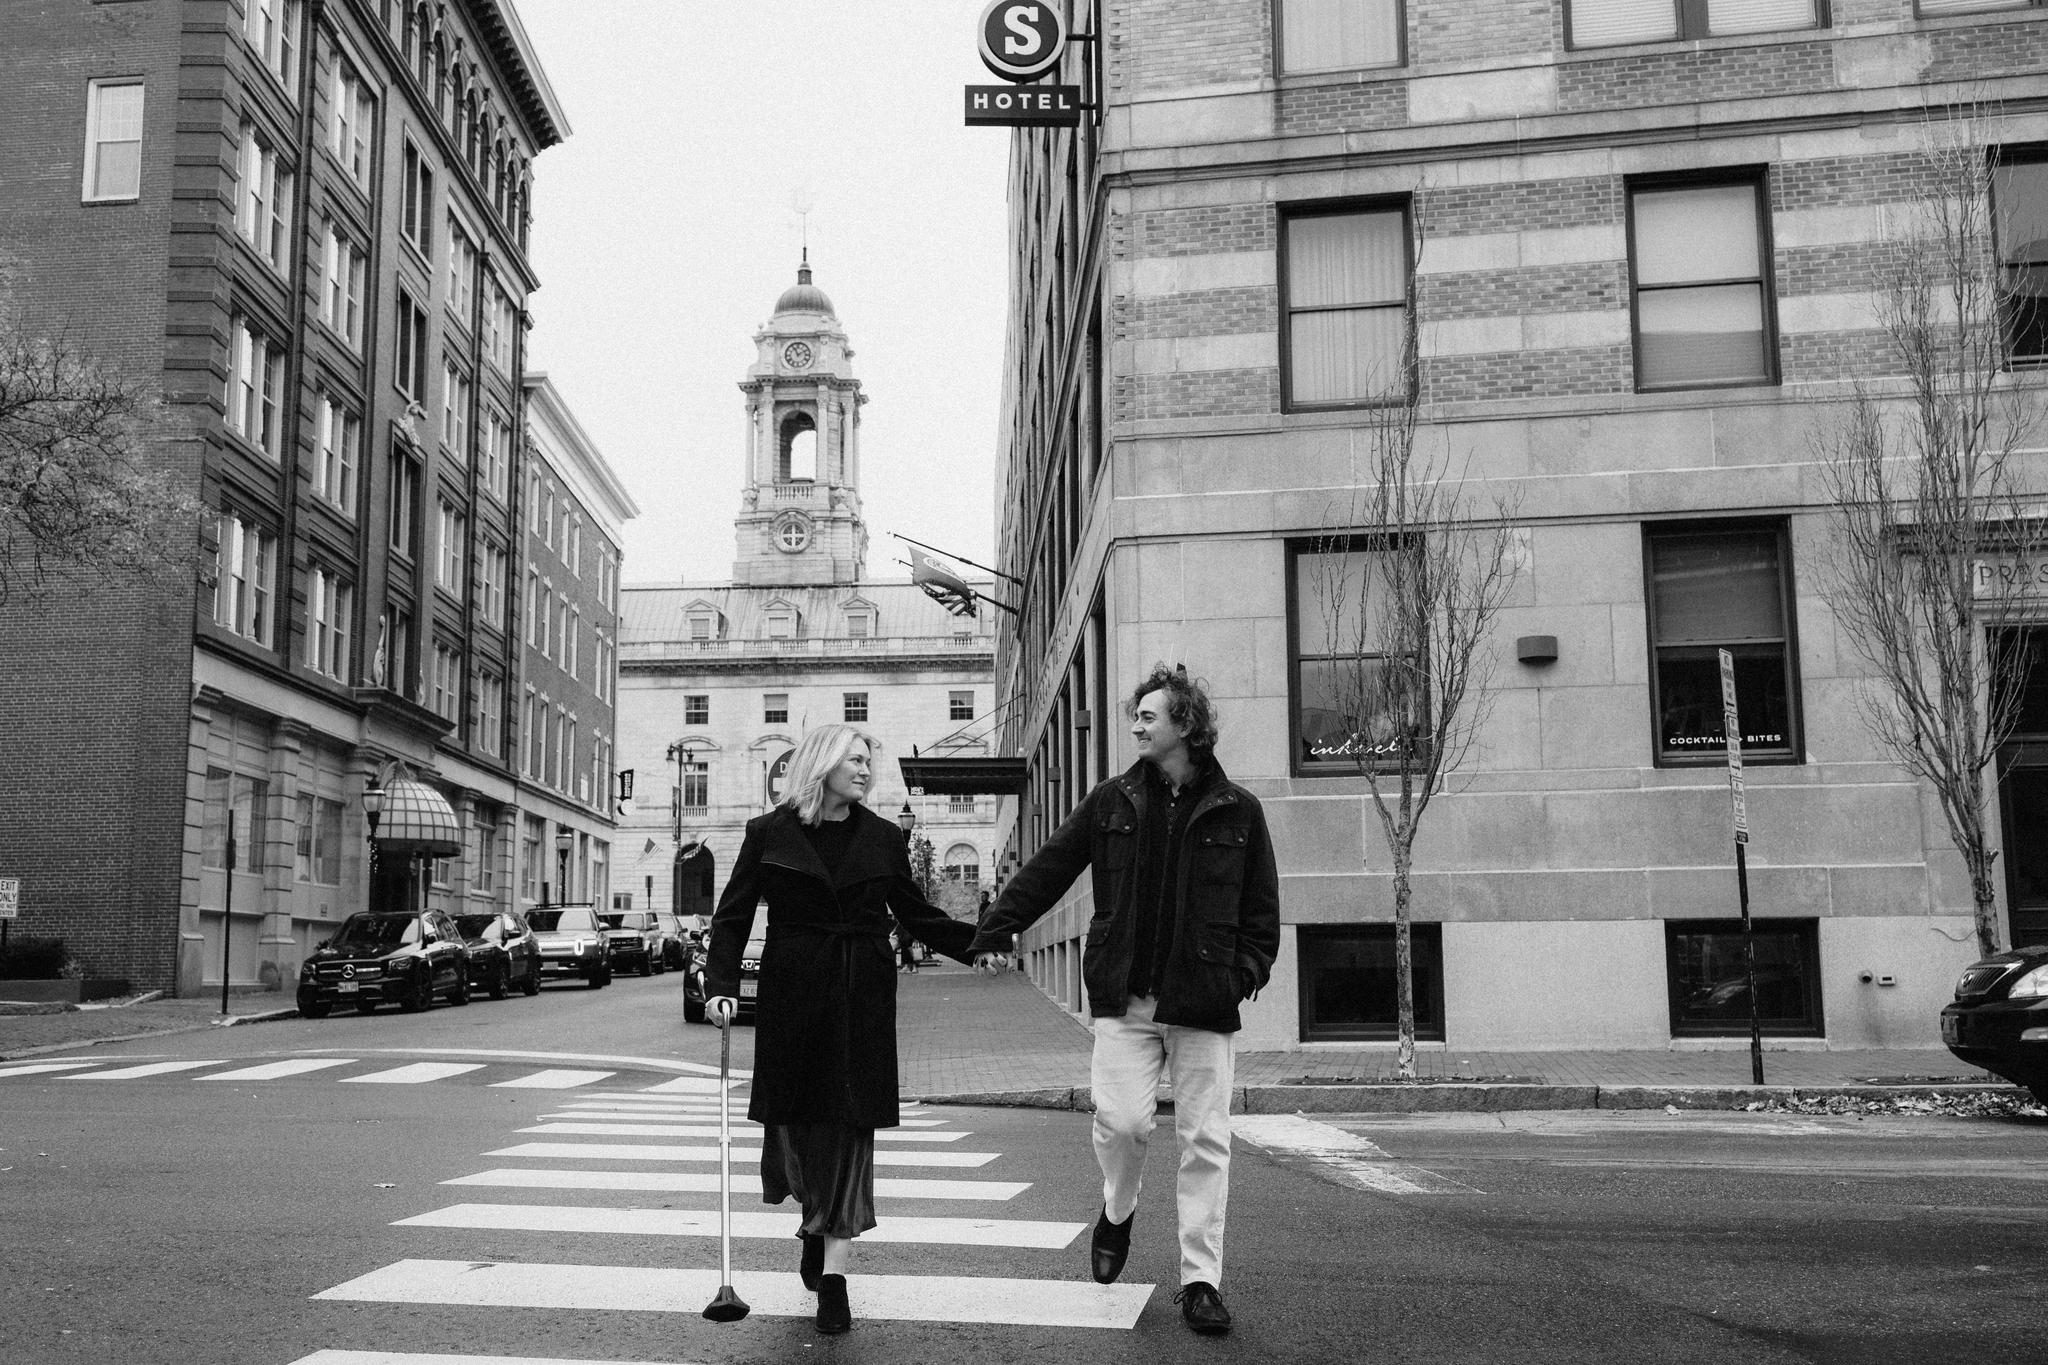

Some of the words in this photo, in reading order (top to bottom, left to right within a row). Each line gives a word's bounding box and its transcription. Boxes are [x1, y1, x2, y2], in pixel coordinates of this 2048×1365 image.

[1004, 5, 1042, 56] S
[973, 93, 1071, 110] HOTEL
[1669, 736, 1727, 745] COCKTAIL
[1747, 734, 1782, 743] BITES
[1, 880, 16, 891] EXIT
